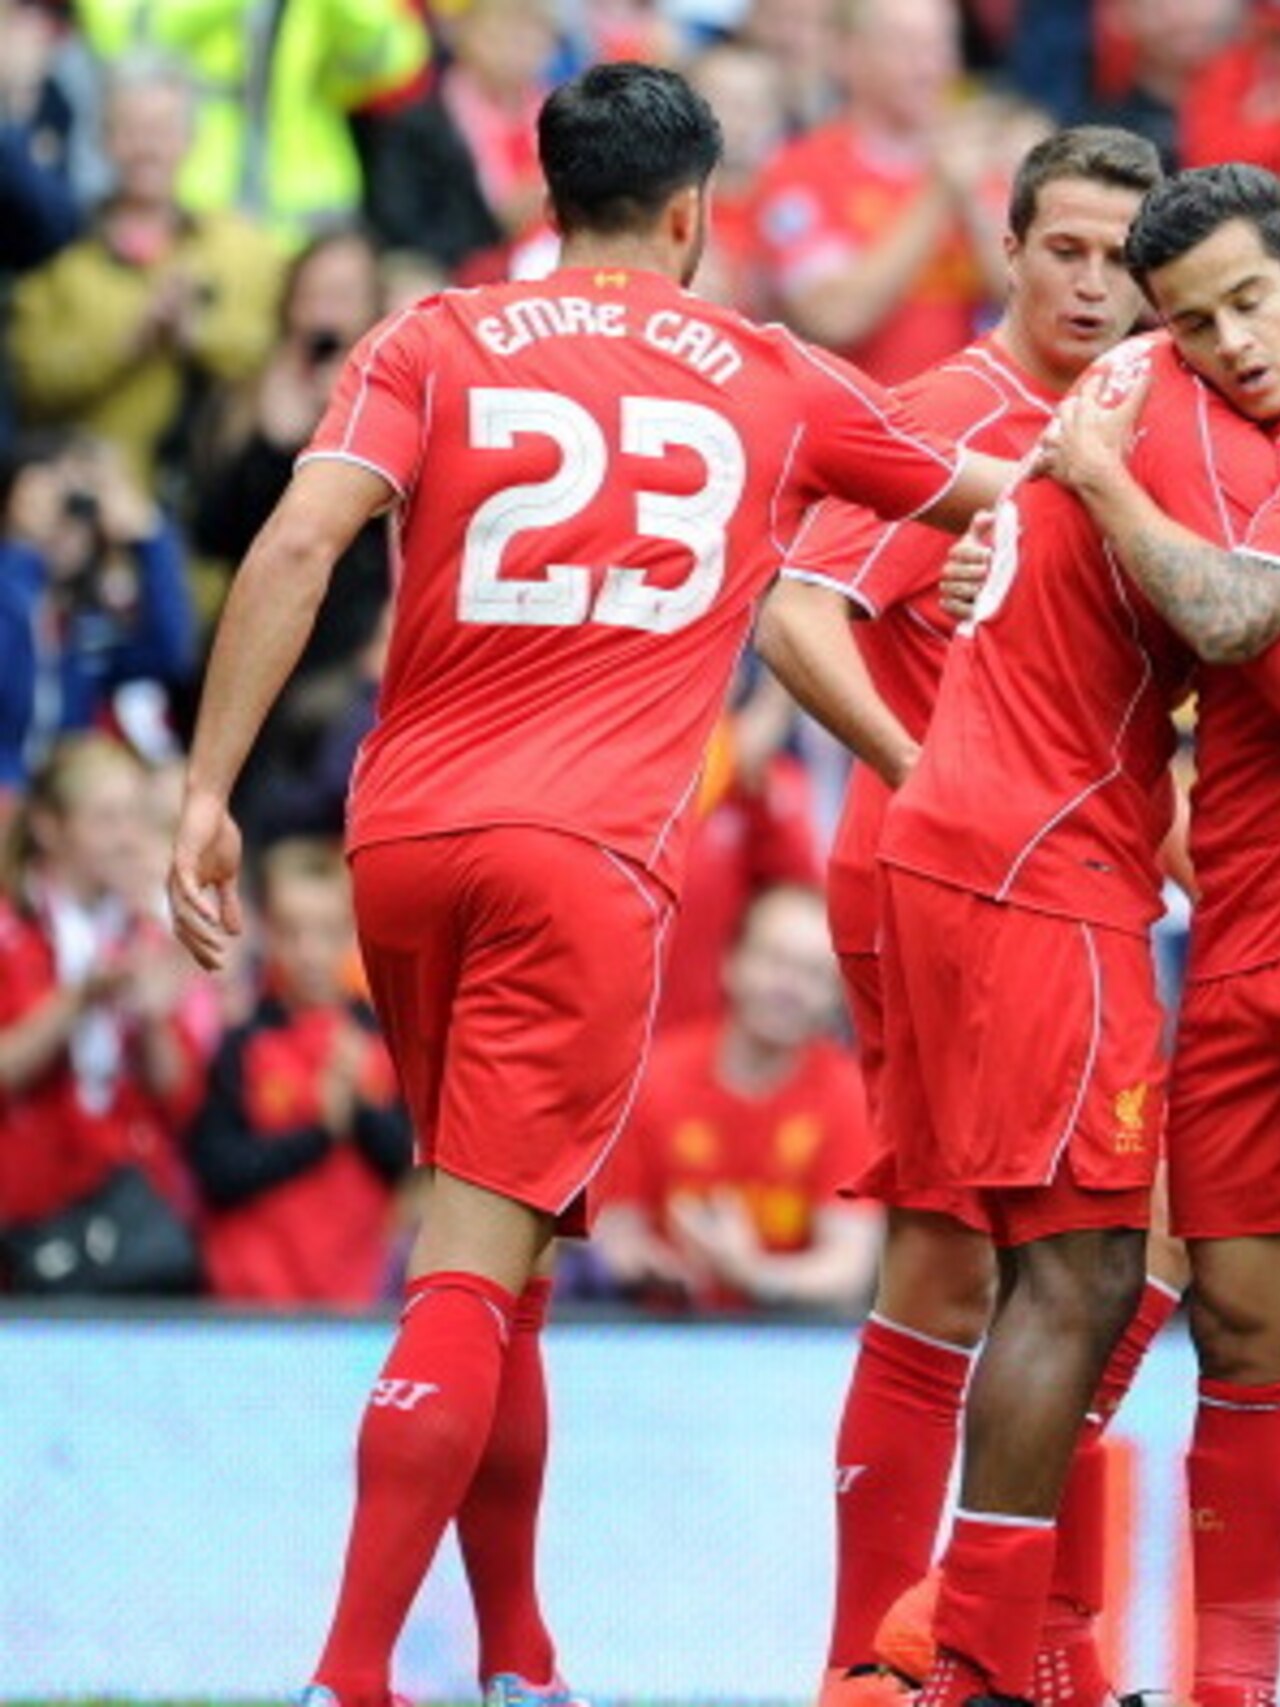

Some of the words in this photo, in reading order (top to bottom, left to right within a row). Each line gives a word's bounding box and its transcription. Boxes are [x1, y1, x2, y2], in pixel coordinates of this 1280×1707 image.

[476, 297, 627, 356] EMRE
[645, 309, 744, 386] CAN
[456, 387, 747, 634] 23
